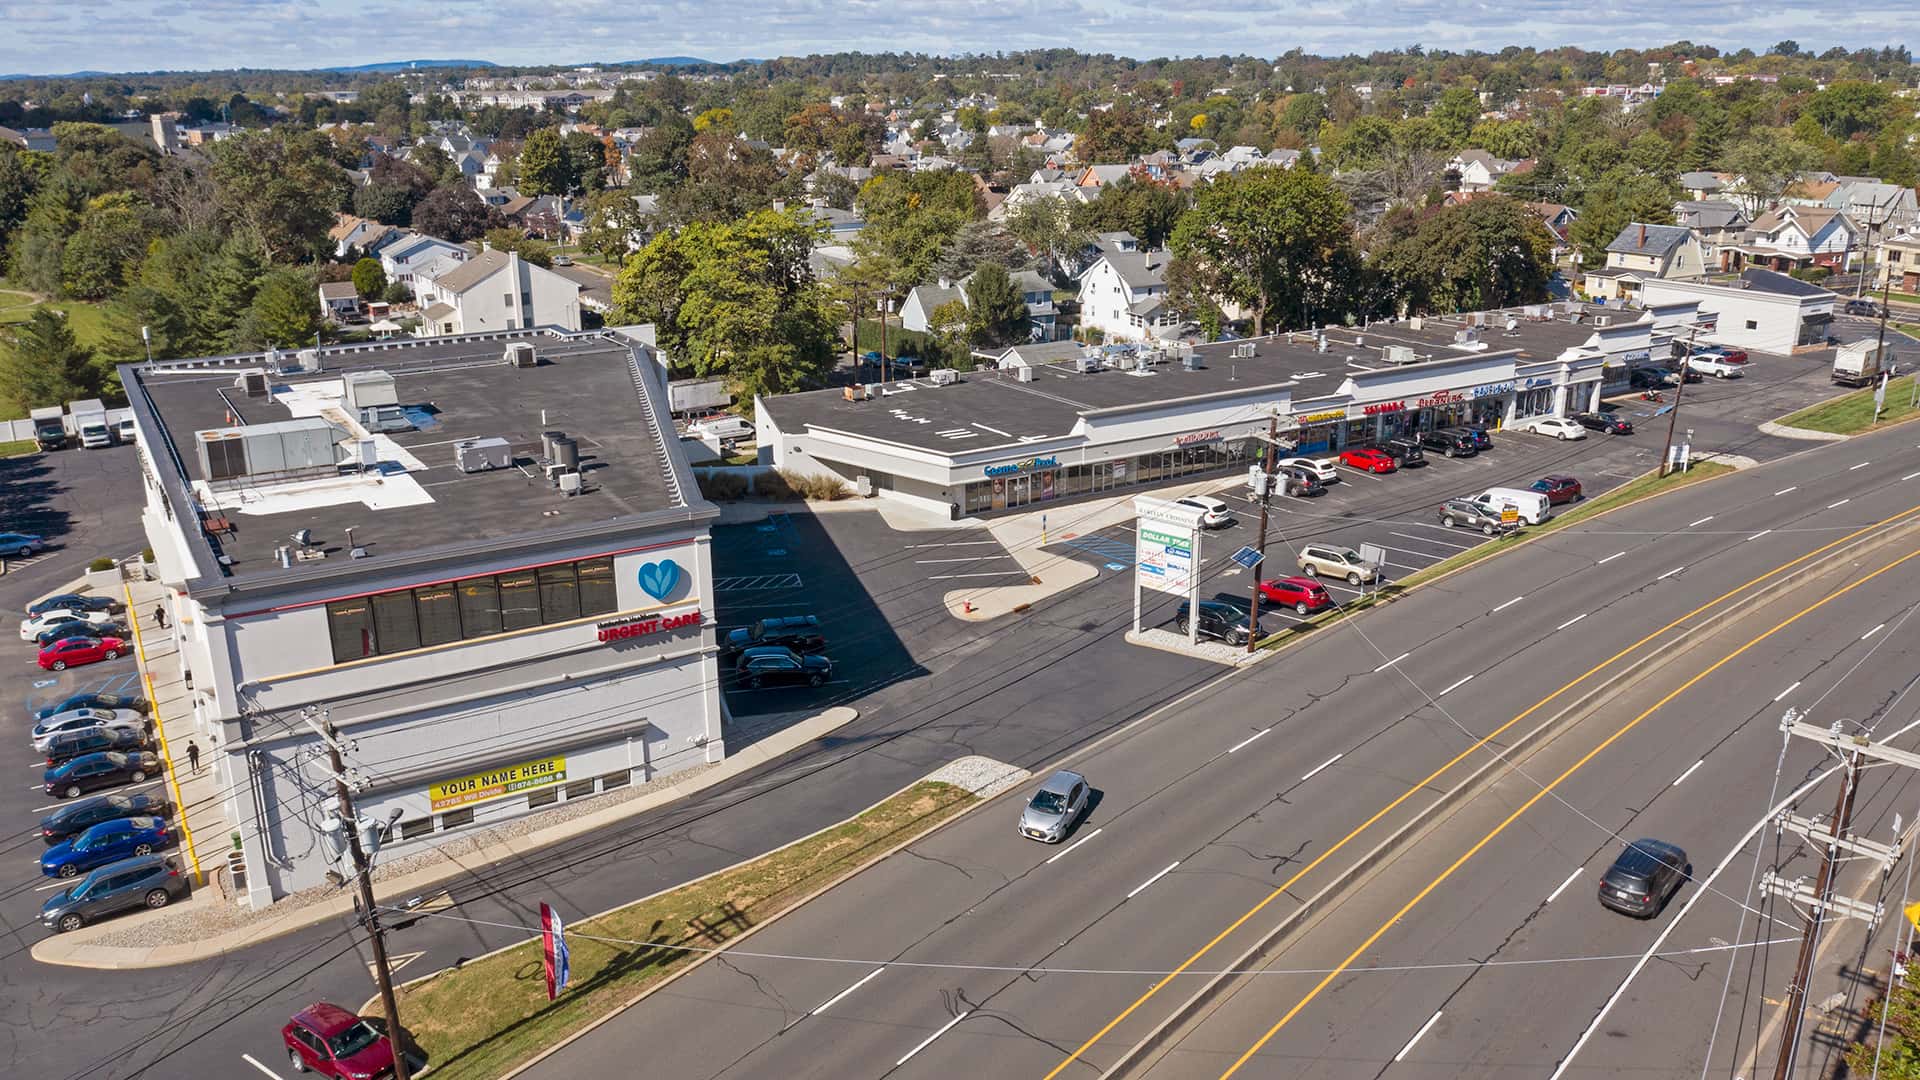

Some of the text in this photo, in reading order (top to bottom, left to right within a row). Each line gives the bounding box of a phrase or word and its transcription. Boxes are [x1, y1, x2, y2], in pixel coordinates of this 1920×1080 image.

[983, 455, 1057, 477] Cosmo Prof
[1142, 531, 1170, 543] DOLLAR
[598, 611, 701, 641] URGENT CARE
[440, 761, 555, 796] YOUR NAME HERE
